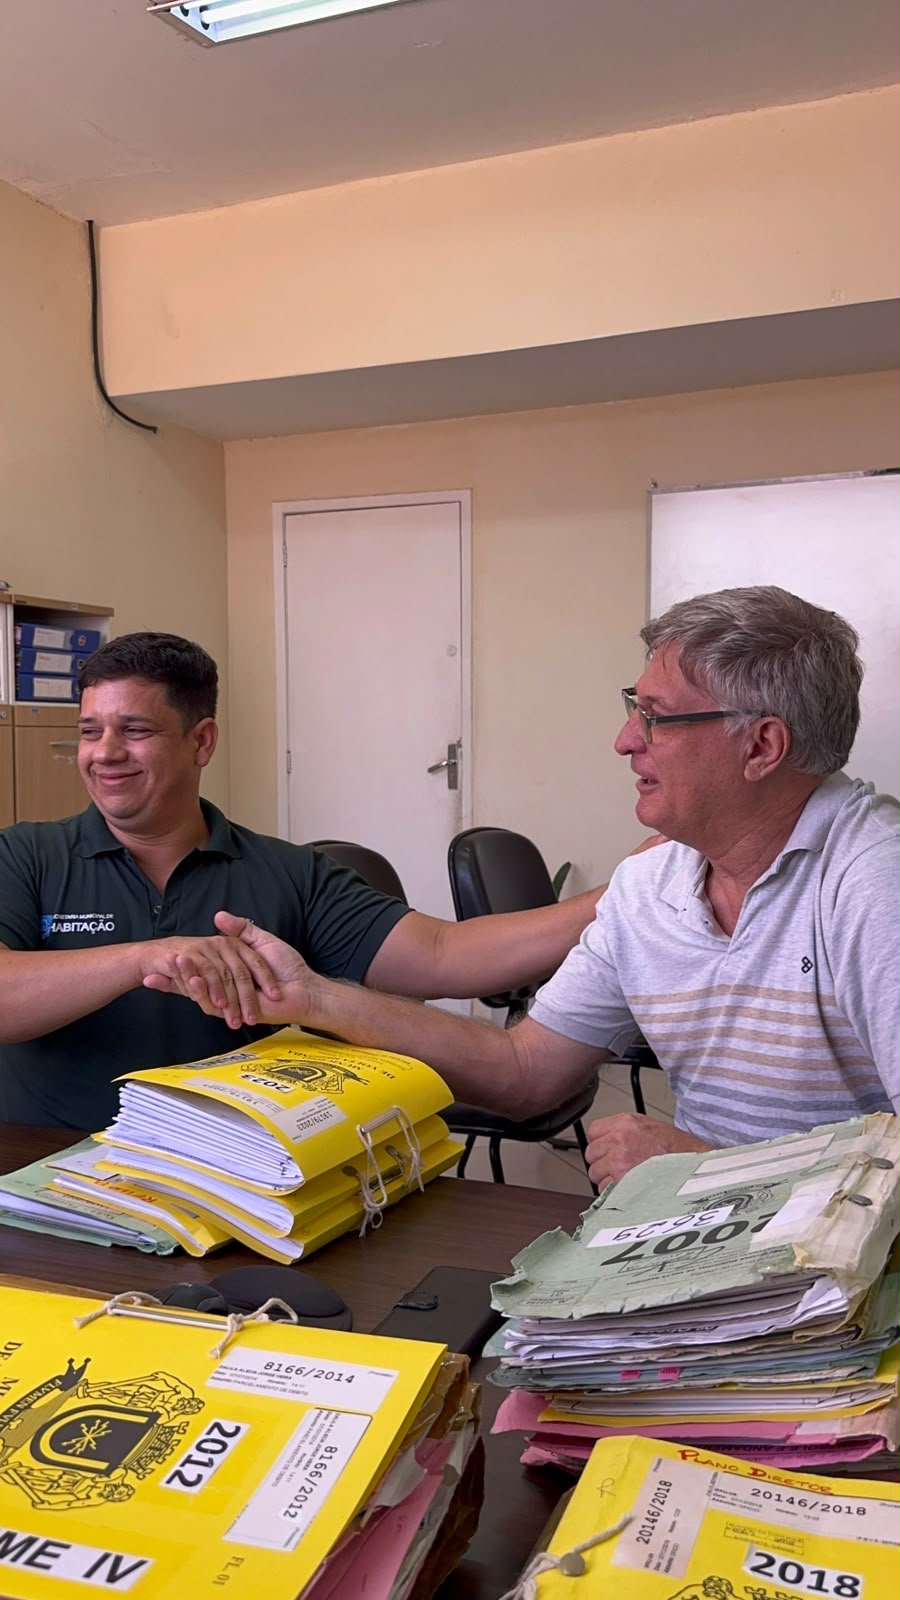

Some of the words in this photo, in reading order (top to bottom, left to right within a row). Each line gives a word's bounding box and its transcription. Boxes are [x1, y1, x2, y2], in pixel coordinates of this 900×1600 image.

[51, 919, 115, 935] HABITAÇÃO
[240, 1074, 291, 1091] 2023
[611, 1210, 720, 1242] 3629
[261, 1361, 356, 1383] 8166/2014
[165, 1421, 242, 1488] 2012
[281, 1445, 339, 1519] 8166/2012
[678, 1449, 740, 1472] PLANO
[746, 1466, 834, 1496] DIRETOR
[634, 1477, 673, 1545] 20146/2018
[750, 1487, 866, 1519] 20146/2018
[81, 1551, 149, 1585] IV
[750, 1552, 861, 1599] 2018
